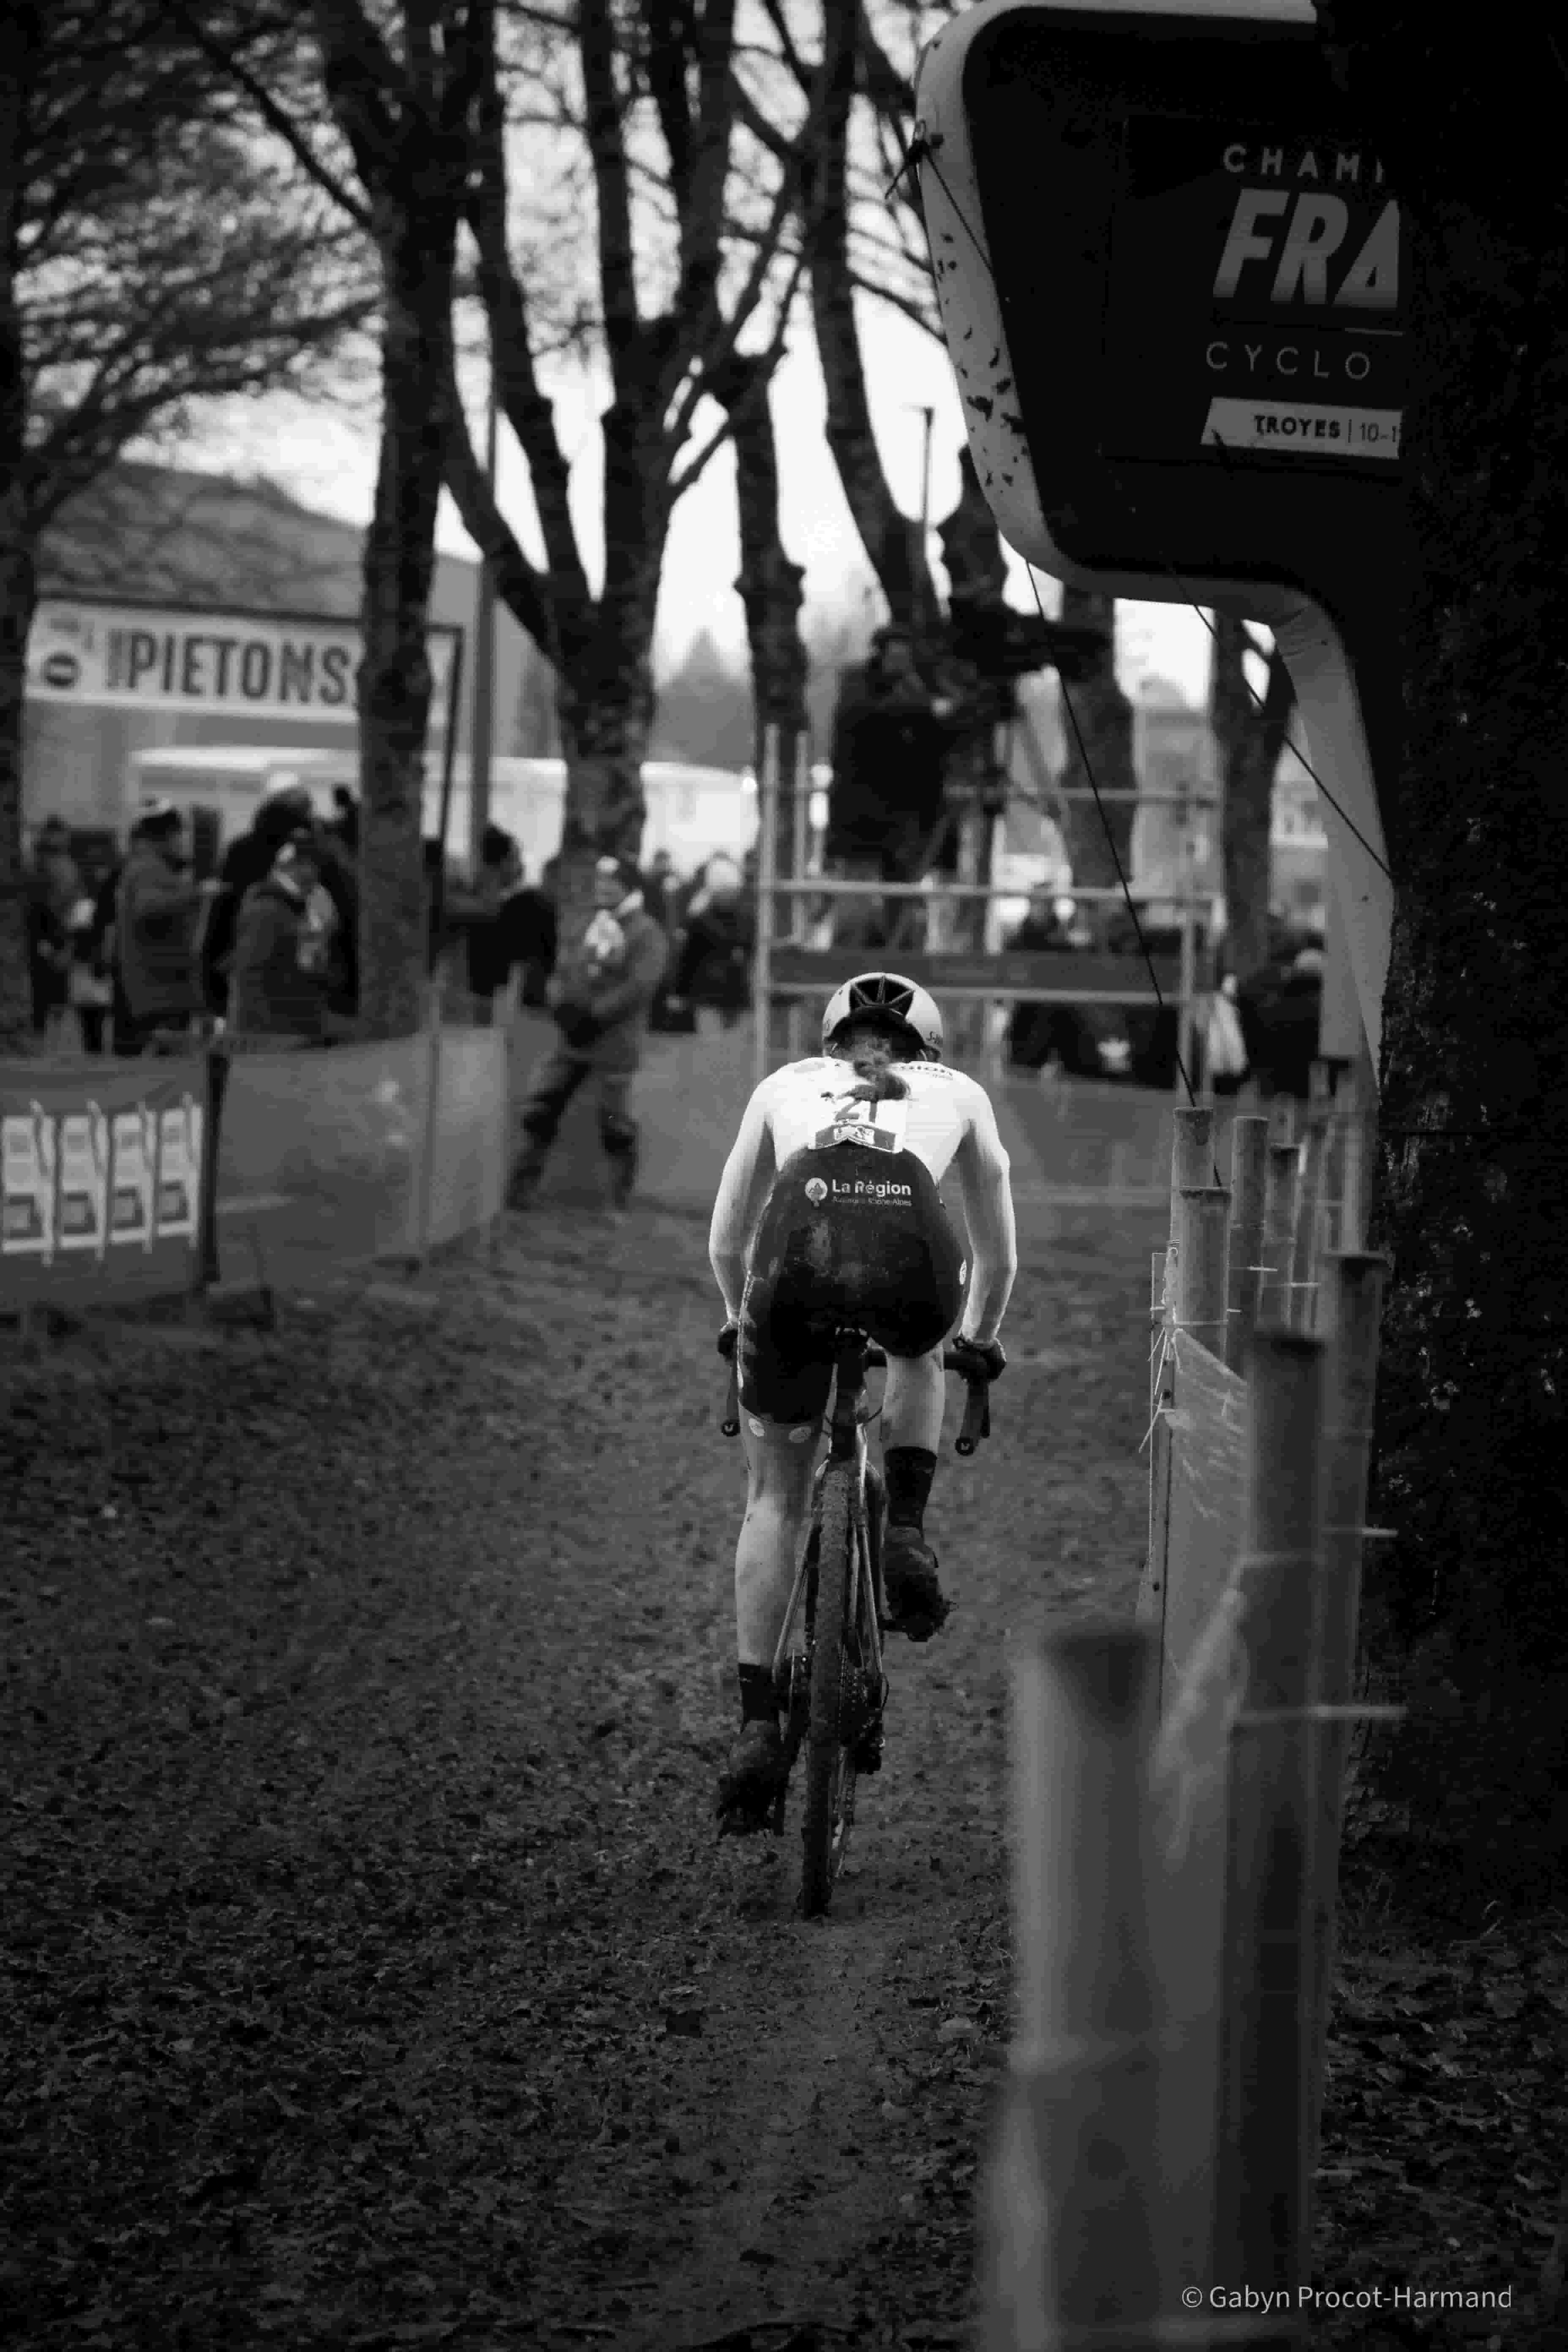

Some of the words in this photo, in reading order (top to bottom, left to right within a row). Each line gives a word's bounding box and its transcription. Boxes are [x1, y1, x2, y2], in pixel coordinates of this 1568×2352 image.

[1213, 188, 1400, 308] FRA
[1254, 415, 1341, 439] TROYES
[127, 629, 350, 705] PIETONS
[832, 1179, 851, 1193] La
[855, 1179, 912, 1198] Région
